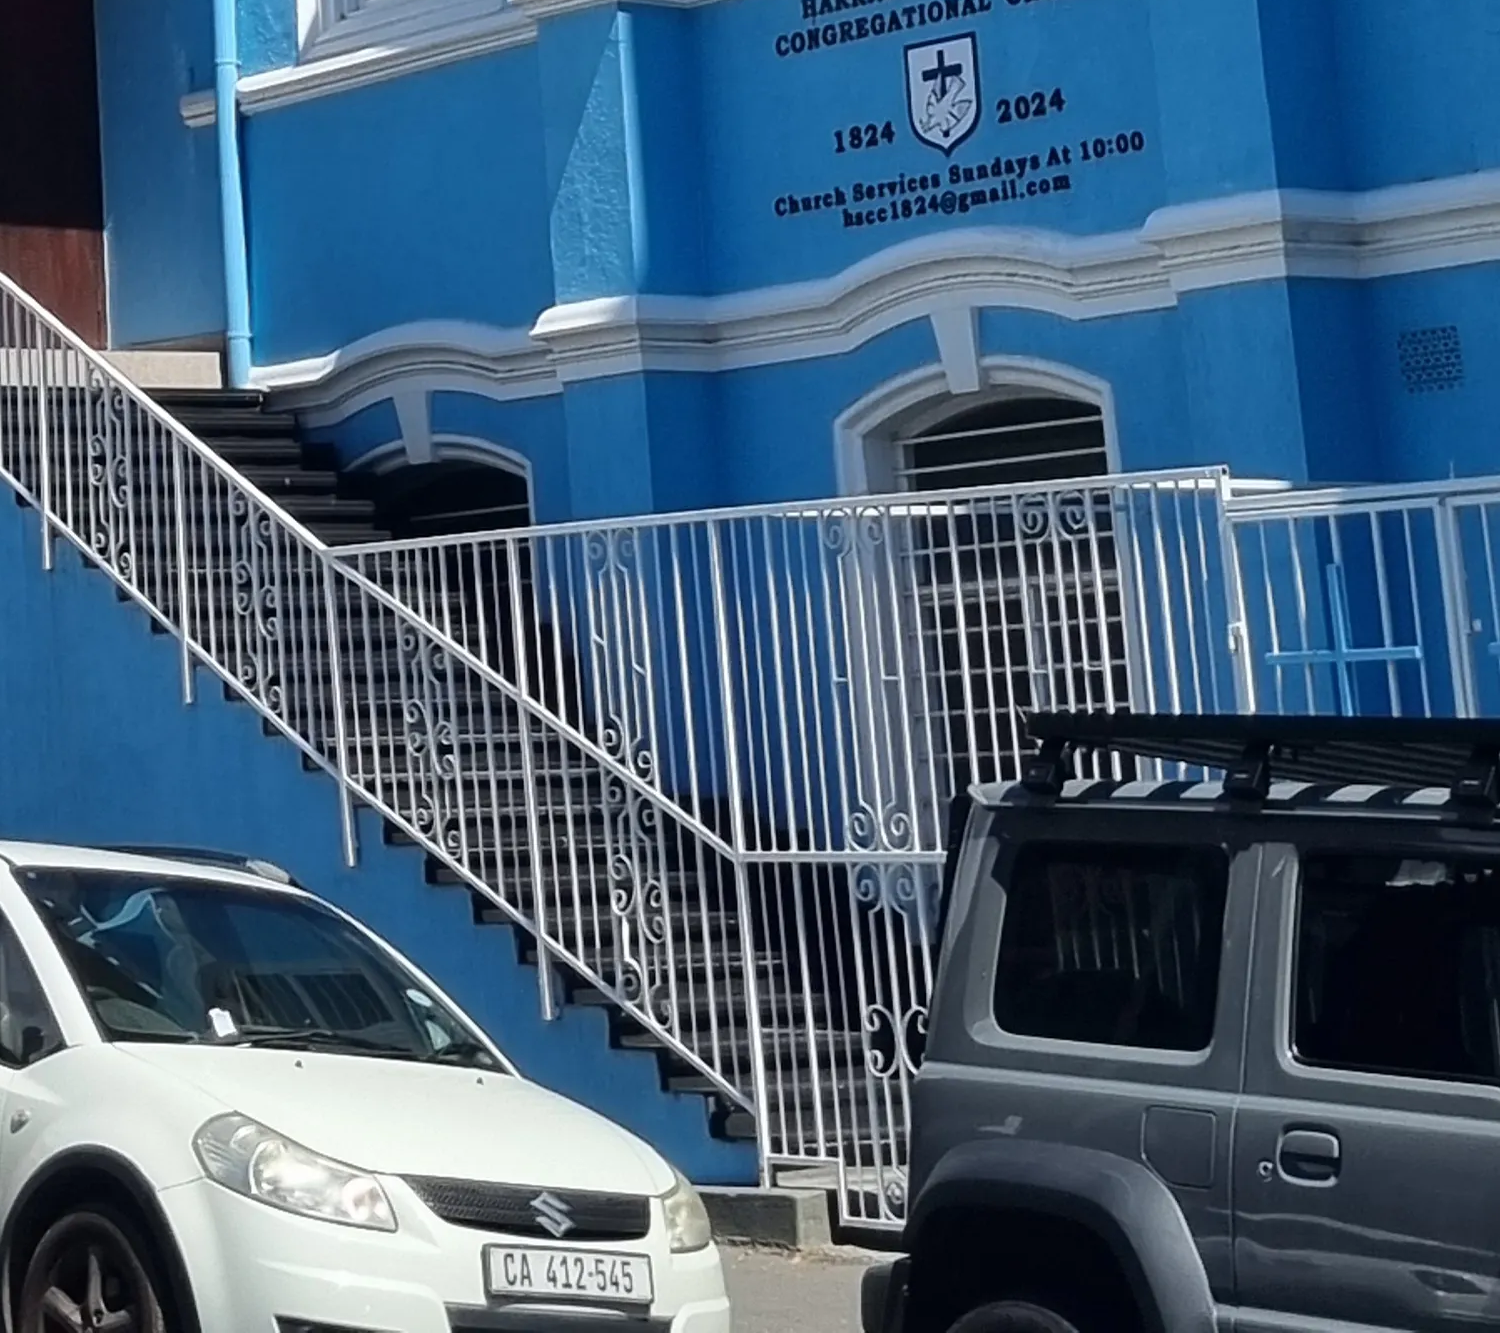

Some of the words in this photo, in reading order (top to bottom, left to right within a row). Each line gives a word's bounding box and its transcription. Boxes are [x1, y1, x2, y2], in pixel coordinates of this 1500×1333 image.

[833, 121, 895, 154] 1824
[996, 88, 1066, 124] 2024
[774, 187, 846, 217] Church
[852, 171, 941, 203] Services
[949, 155, 1040, 192] Sundays
[1046, 146, 1072, 168] At
[1080, 132, 1145, 162] 10:00
[843, 173, 1071, 228] hscc1824@gmail.com
[503, 1253, 532, 1287] CA
